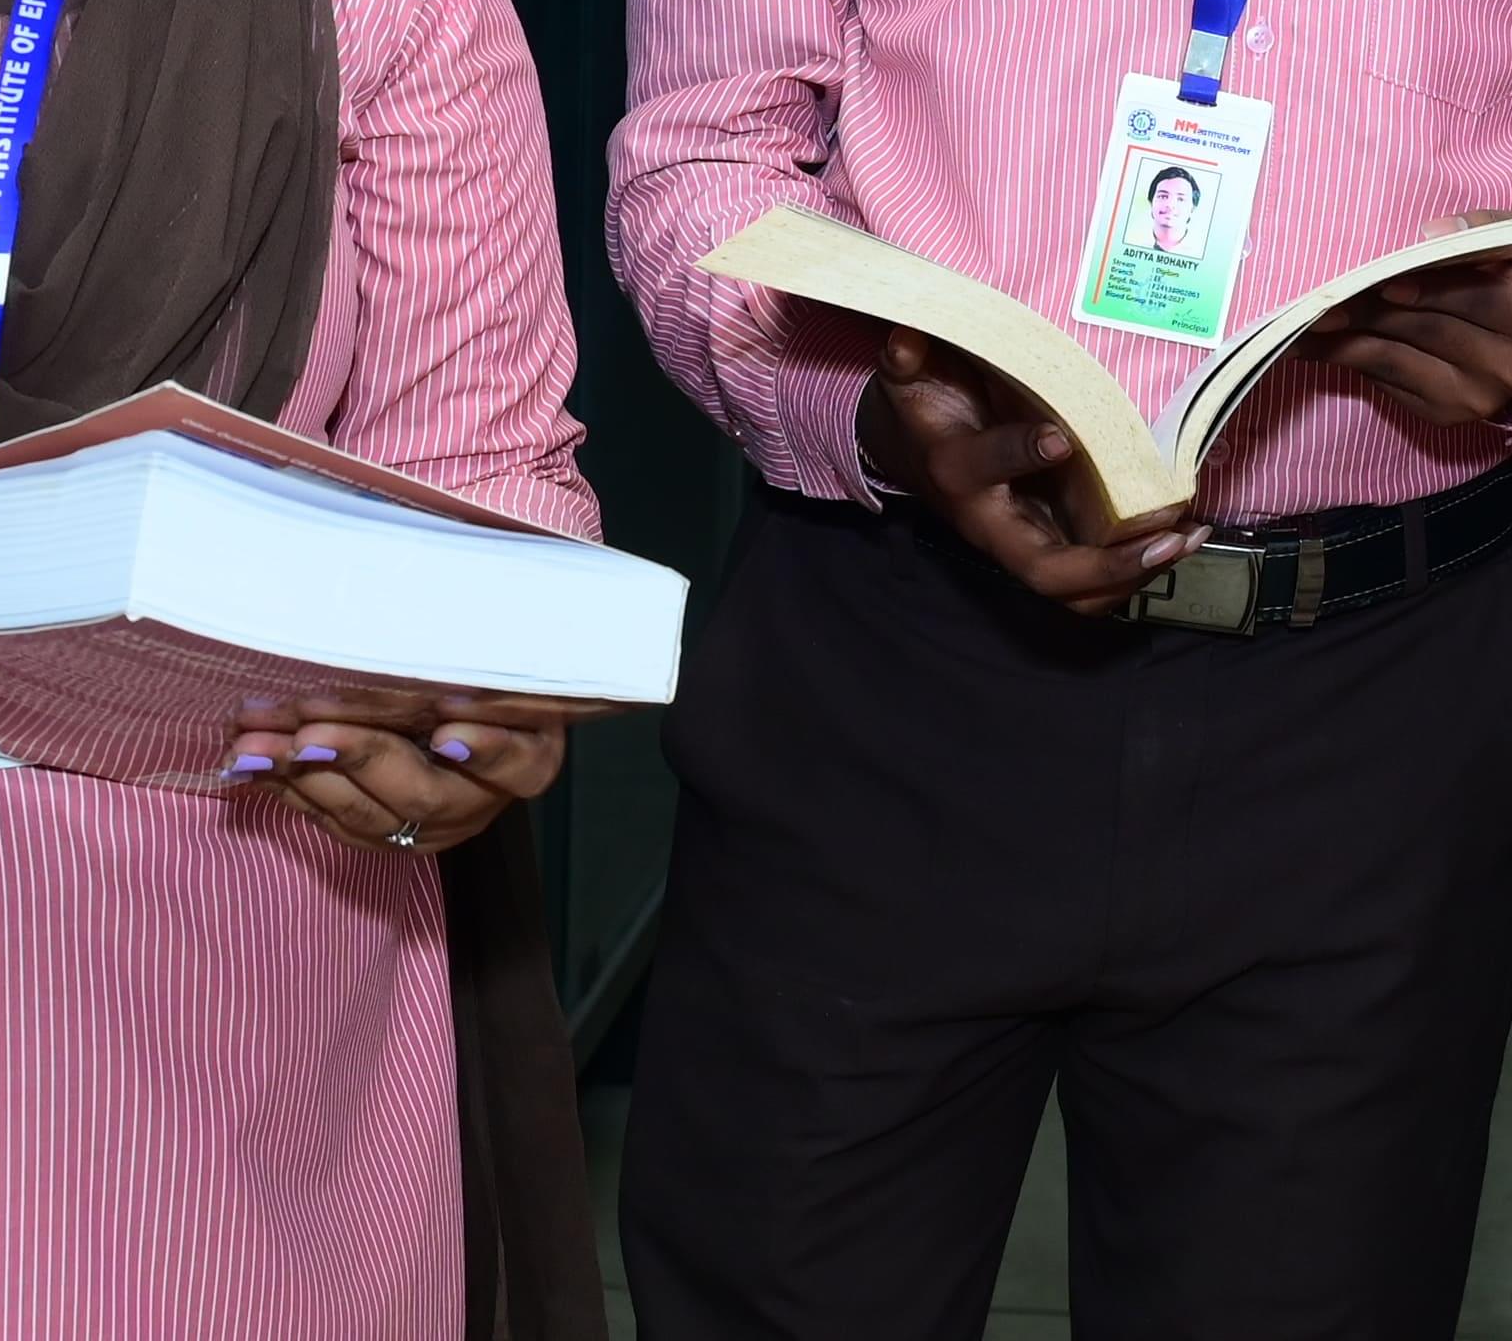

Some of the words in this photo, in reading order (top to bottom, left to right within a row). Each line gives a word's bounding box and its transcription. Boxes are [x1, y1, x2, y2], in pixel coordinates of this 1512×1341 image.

[11, 22, 40, 55] OF
[1173, 118, 1199, 134] NM
[1122, 247, 1155, 263] ADITYA
[1155, 253, 1200, 272] MOHANTY
[1171, 318, 1210, 334] Principal
